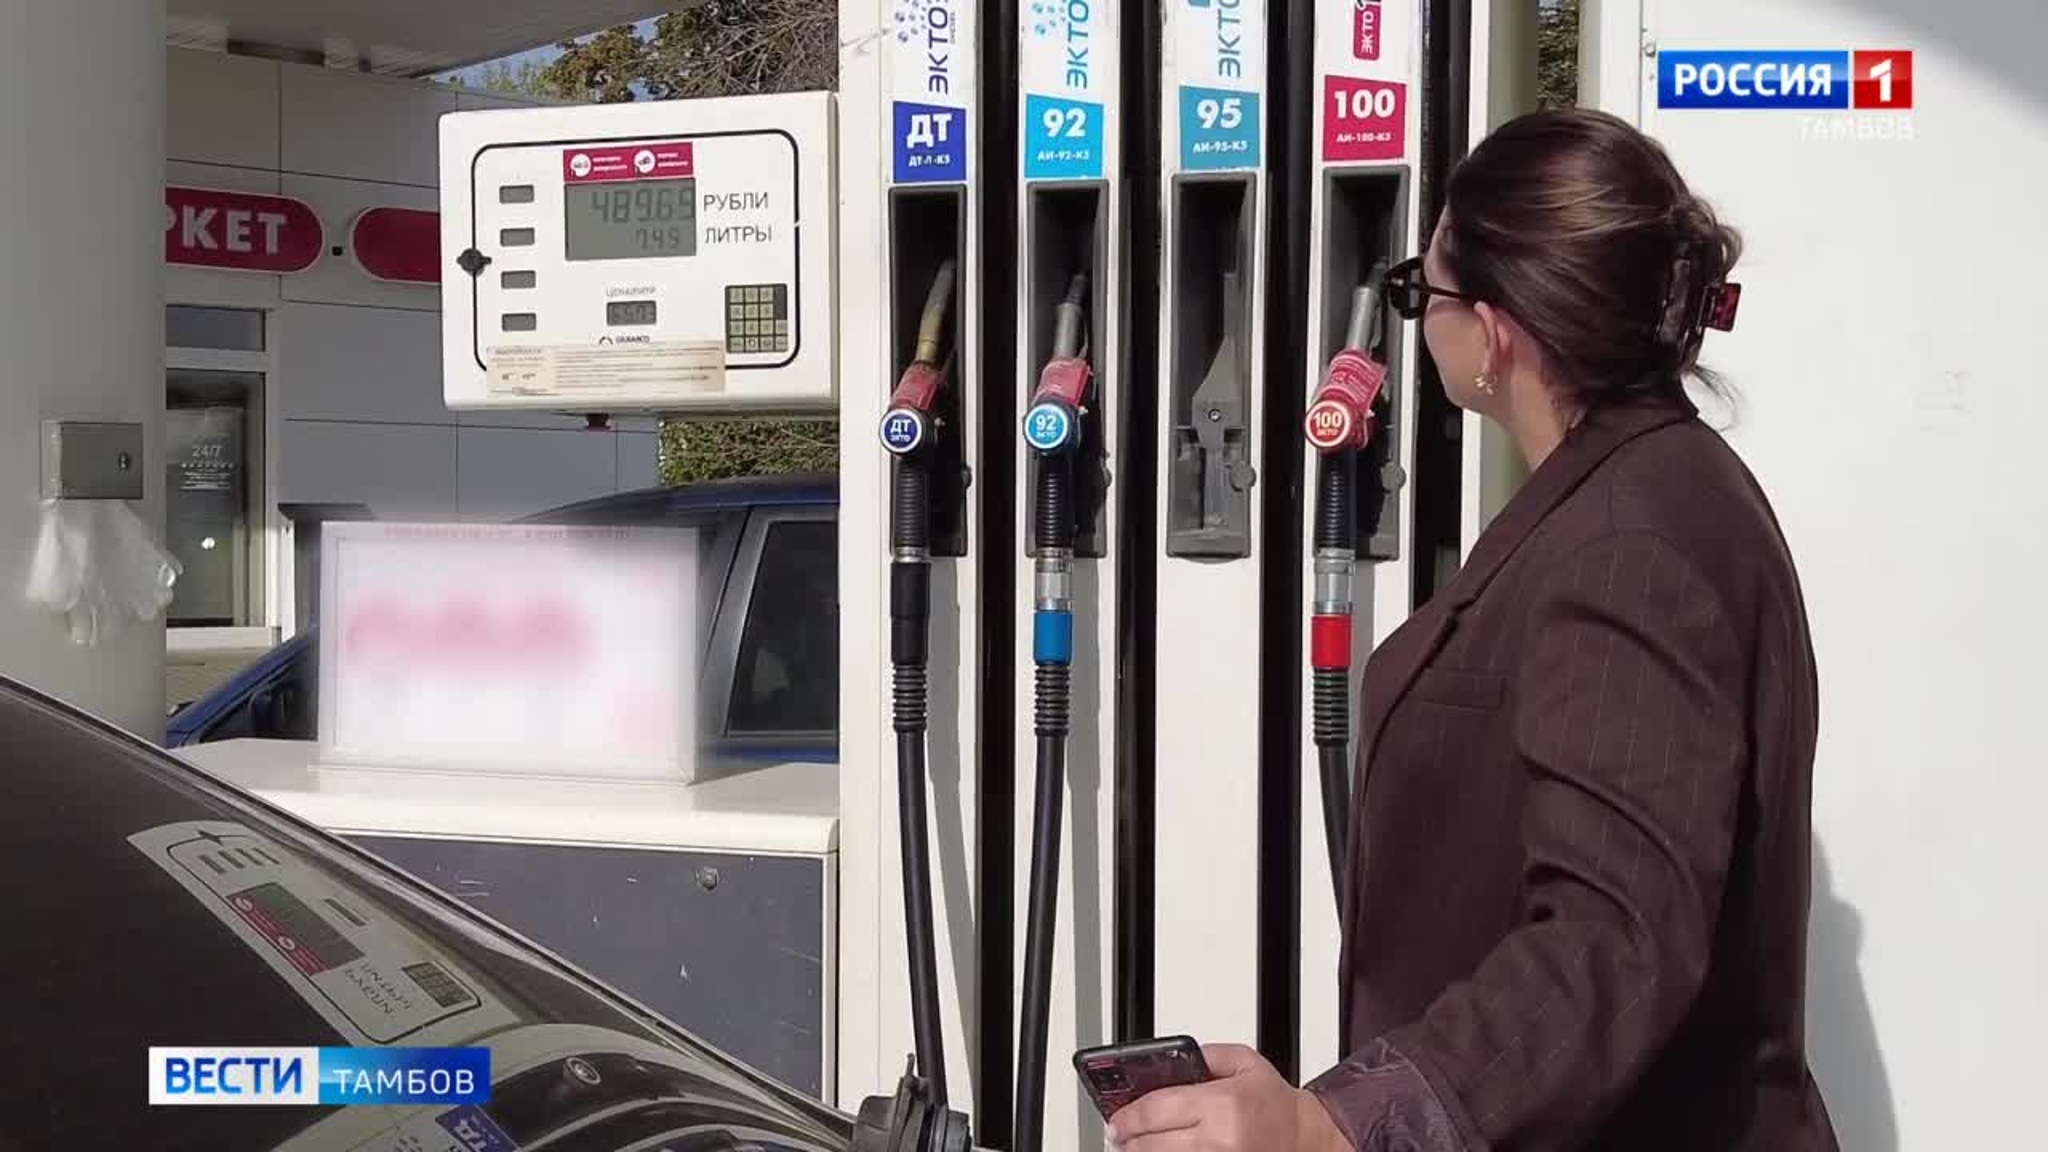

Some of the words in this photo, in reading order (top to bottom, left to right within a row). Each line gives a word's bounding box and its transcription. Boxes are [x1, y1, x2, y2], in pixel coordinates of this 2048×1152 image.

[1362, 11, 1374, 54] ЭКТО
[928, 6, 948, 94] ЭКТО
[1197, 97, 1242, 129] 95
[1334, 88, 1396, 119] 100
[906, 113, 953, 149] ДТ
[1042, 107, 1087, 138] 92
[703, 191, 769, 211] РУБЛИ
[705, 226, 772, 244] ЛИТРЫ
[890, 418, 912, 433] ДТ
[1036, 415, 1057, 431] 92
[1314, 411, 1342, 428] 100
